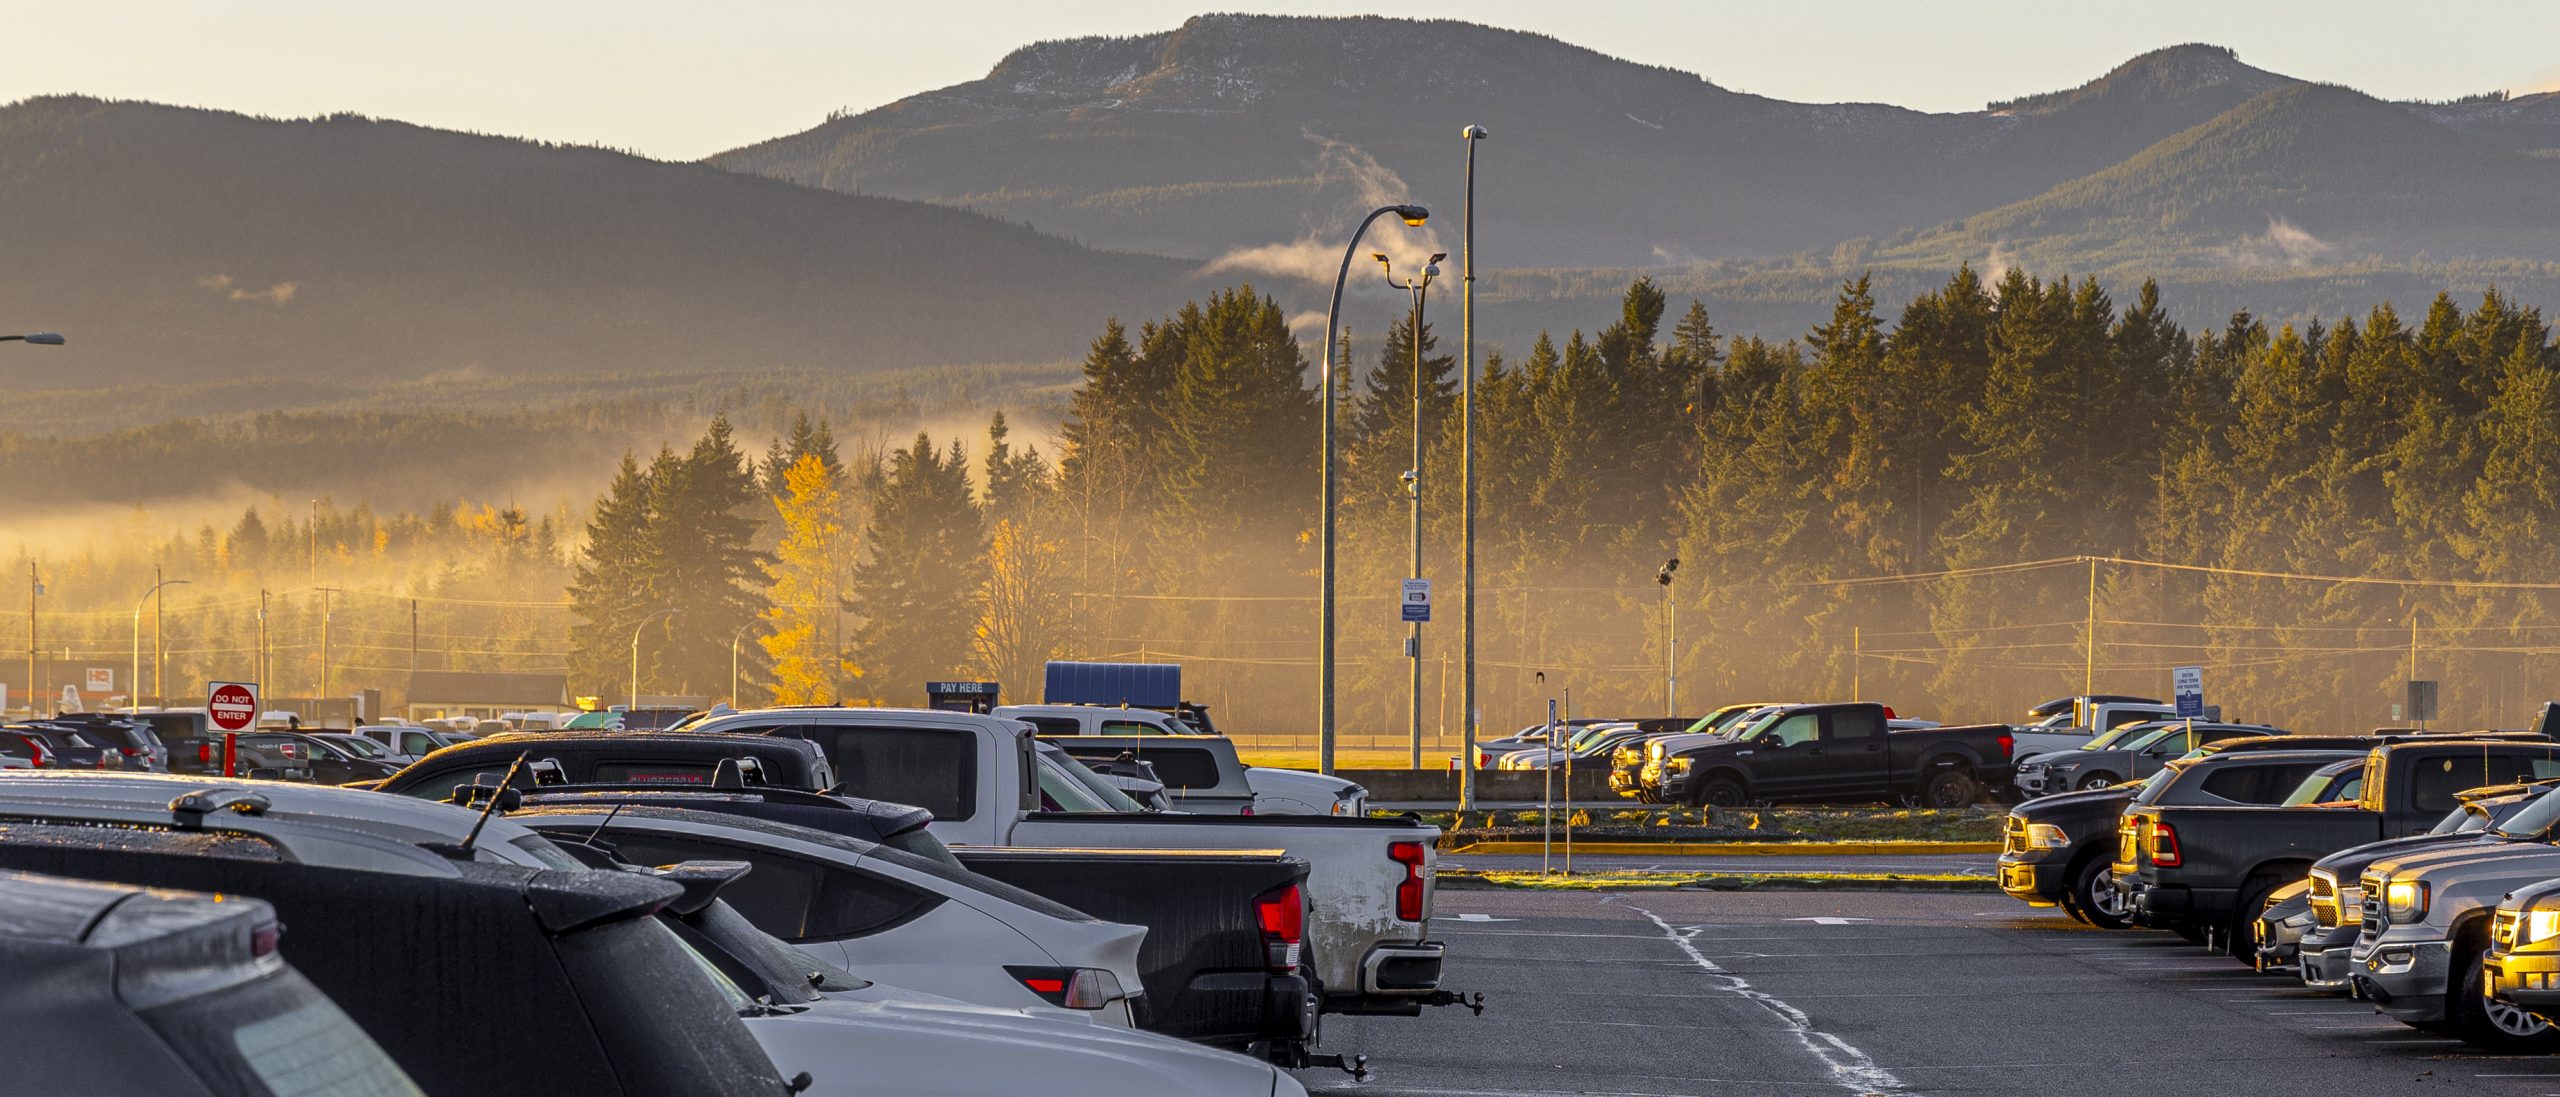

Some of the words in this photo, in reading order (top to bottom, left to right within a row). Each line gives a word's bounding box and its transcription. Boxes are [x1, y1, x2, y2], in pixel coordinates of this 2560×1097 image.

[940, 683, 957, 693] PAY
[959, 683, 983, 693] HERE
[215, 694, 229, 703] DO
[231, 695, 250, 704] NOT
[217, 711, 247, 720] ENTER
